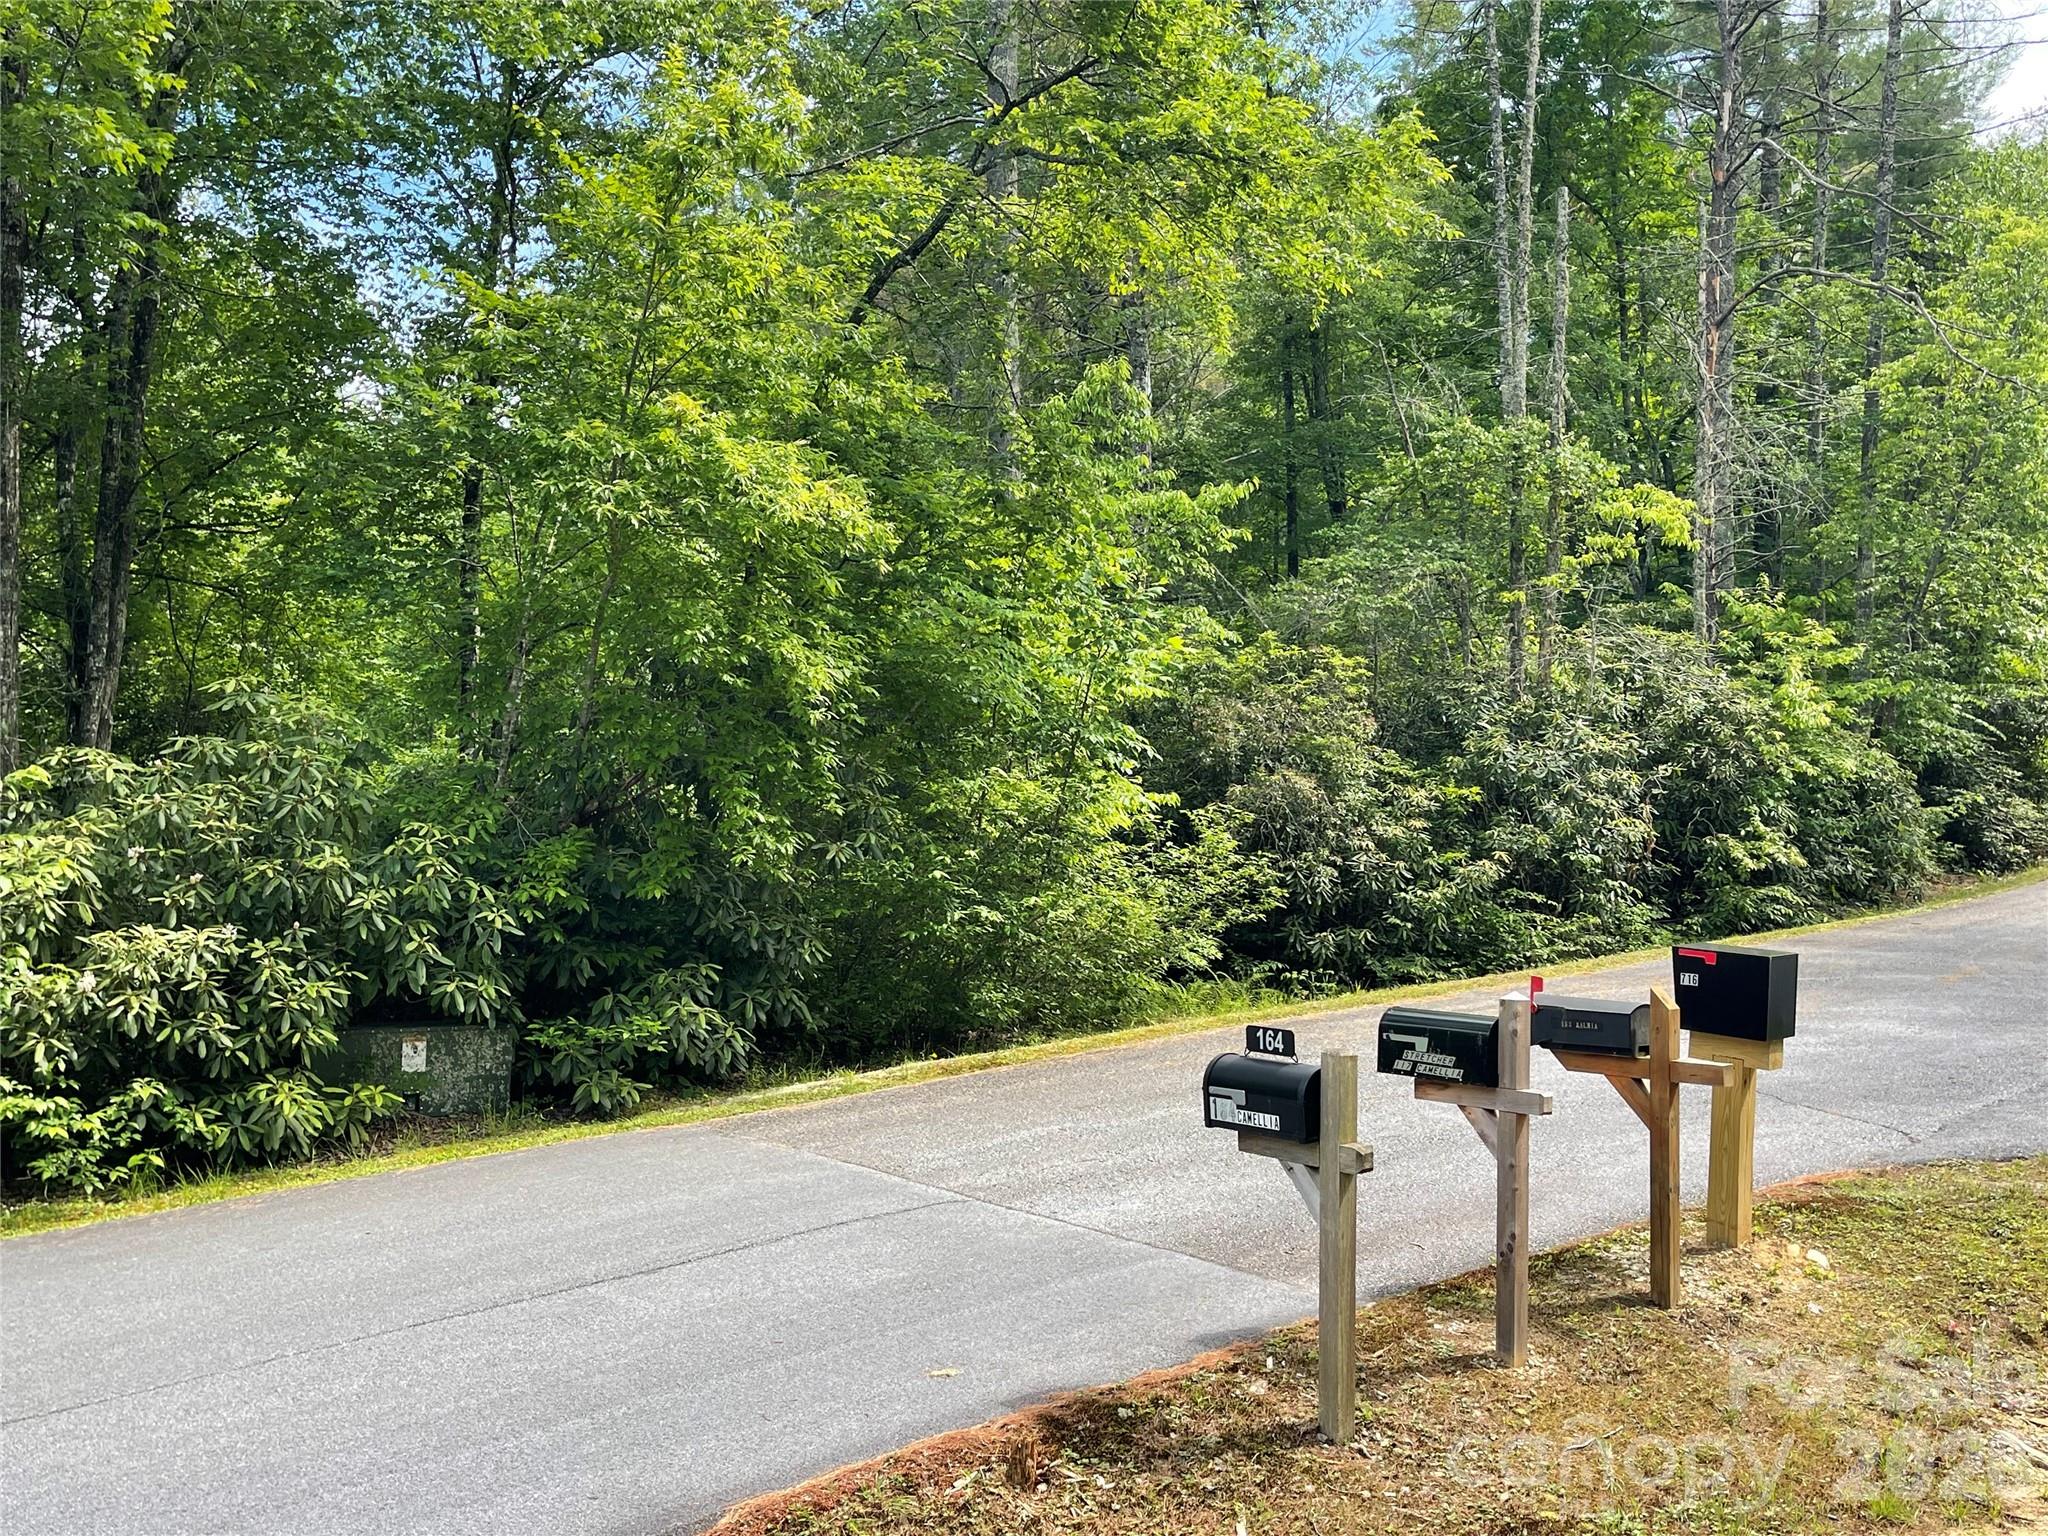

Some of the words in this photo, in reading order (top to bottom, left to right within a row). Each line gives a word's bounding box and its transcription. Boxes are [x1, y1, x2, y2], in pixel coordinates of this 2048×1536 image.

[1681, 973, 1698, 985] 716
[1256, 1028, 1284, 1053] 164
[1403, 1051, 1454, 1066] STRETCHER
[1395, 1061, 1411, 1071] 117
[1416, 1064, 1462, 1078] CAMELLIA
[1236, 1110, 1280, 1131] CAMELLIA
